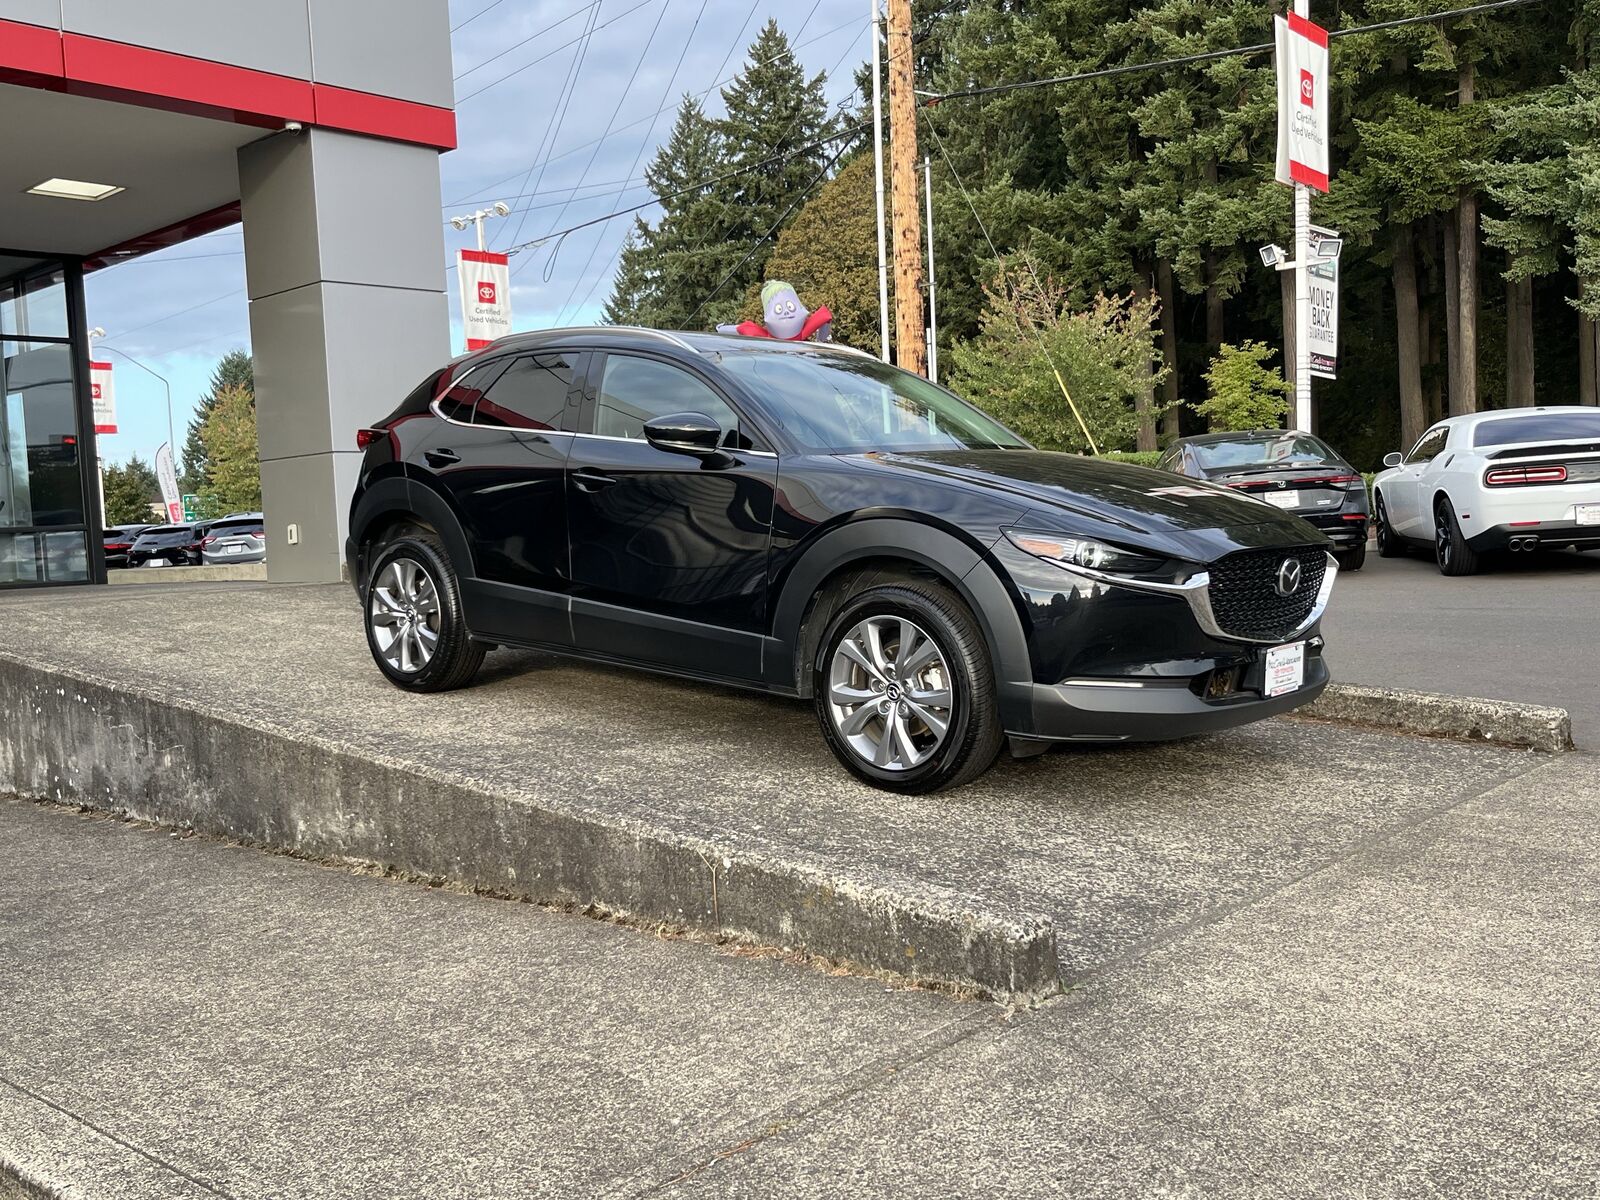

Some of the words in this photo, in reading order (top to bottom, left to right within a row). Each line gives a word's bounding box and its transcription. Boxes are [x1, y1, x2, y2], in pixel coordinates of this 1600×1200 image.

[1296, 110, 1316, 128] Certified
[1291, 121, 1303, 136] Used
[1304, 128, 1322, 145] Vehicles
[1309, 286, 1334, 309] MONEY
[468, 315, 484, 323] Used
[485, 316, 508, 325] Vehicles
[475, 306, 501, 316] Certified
[1312, 306, 1331, 329] BACK
